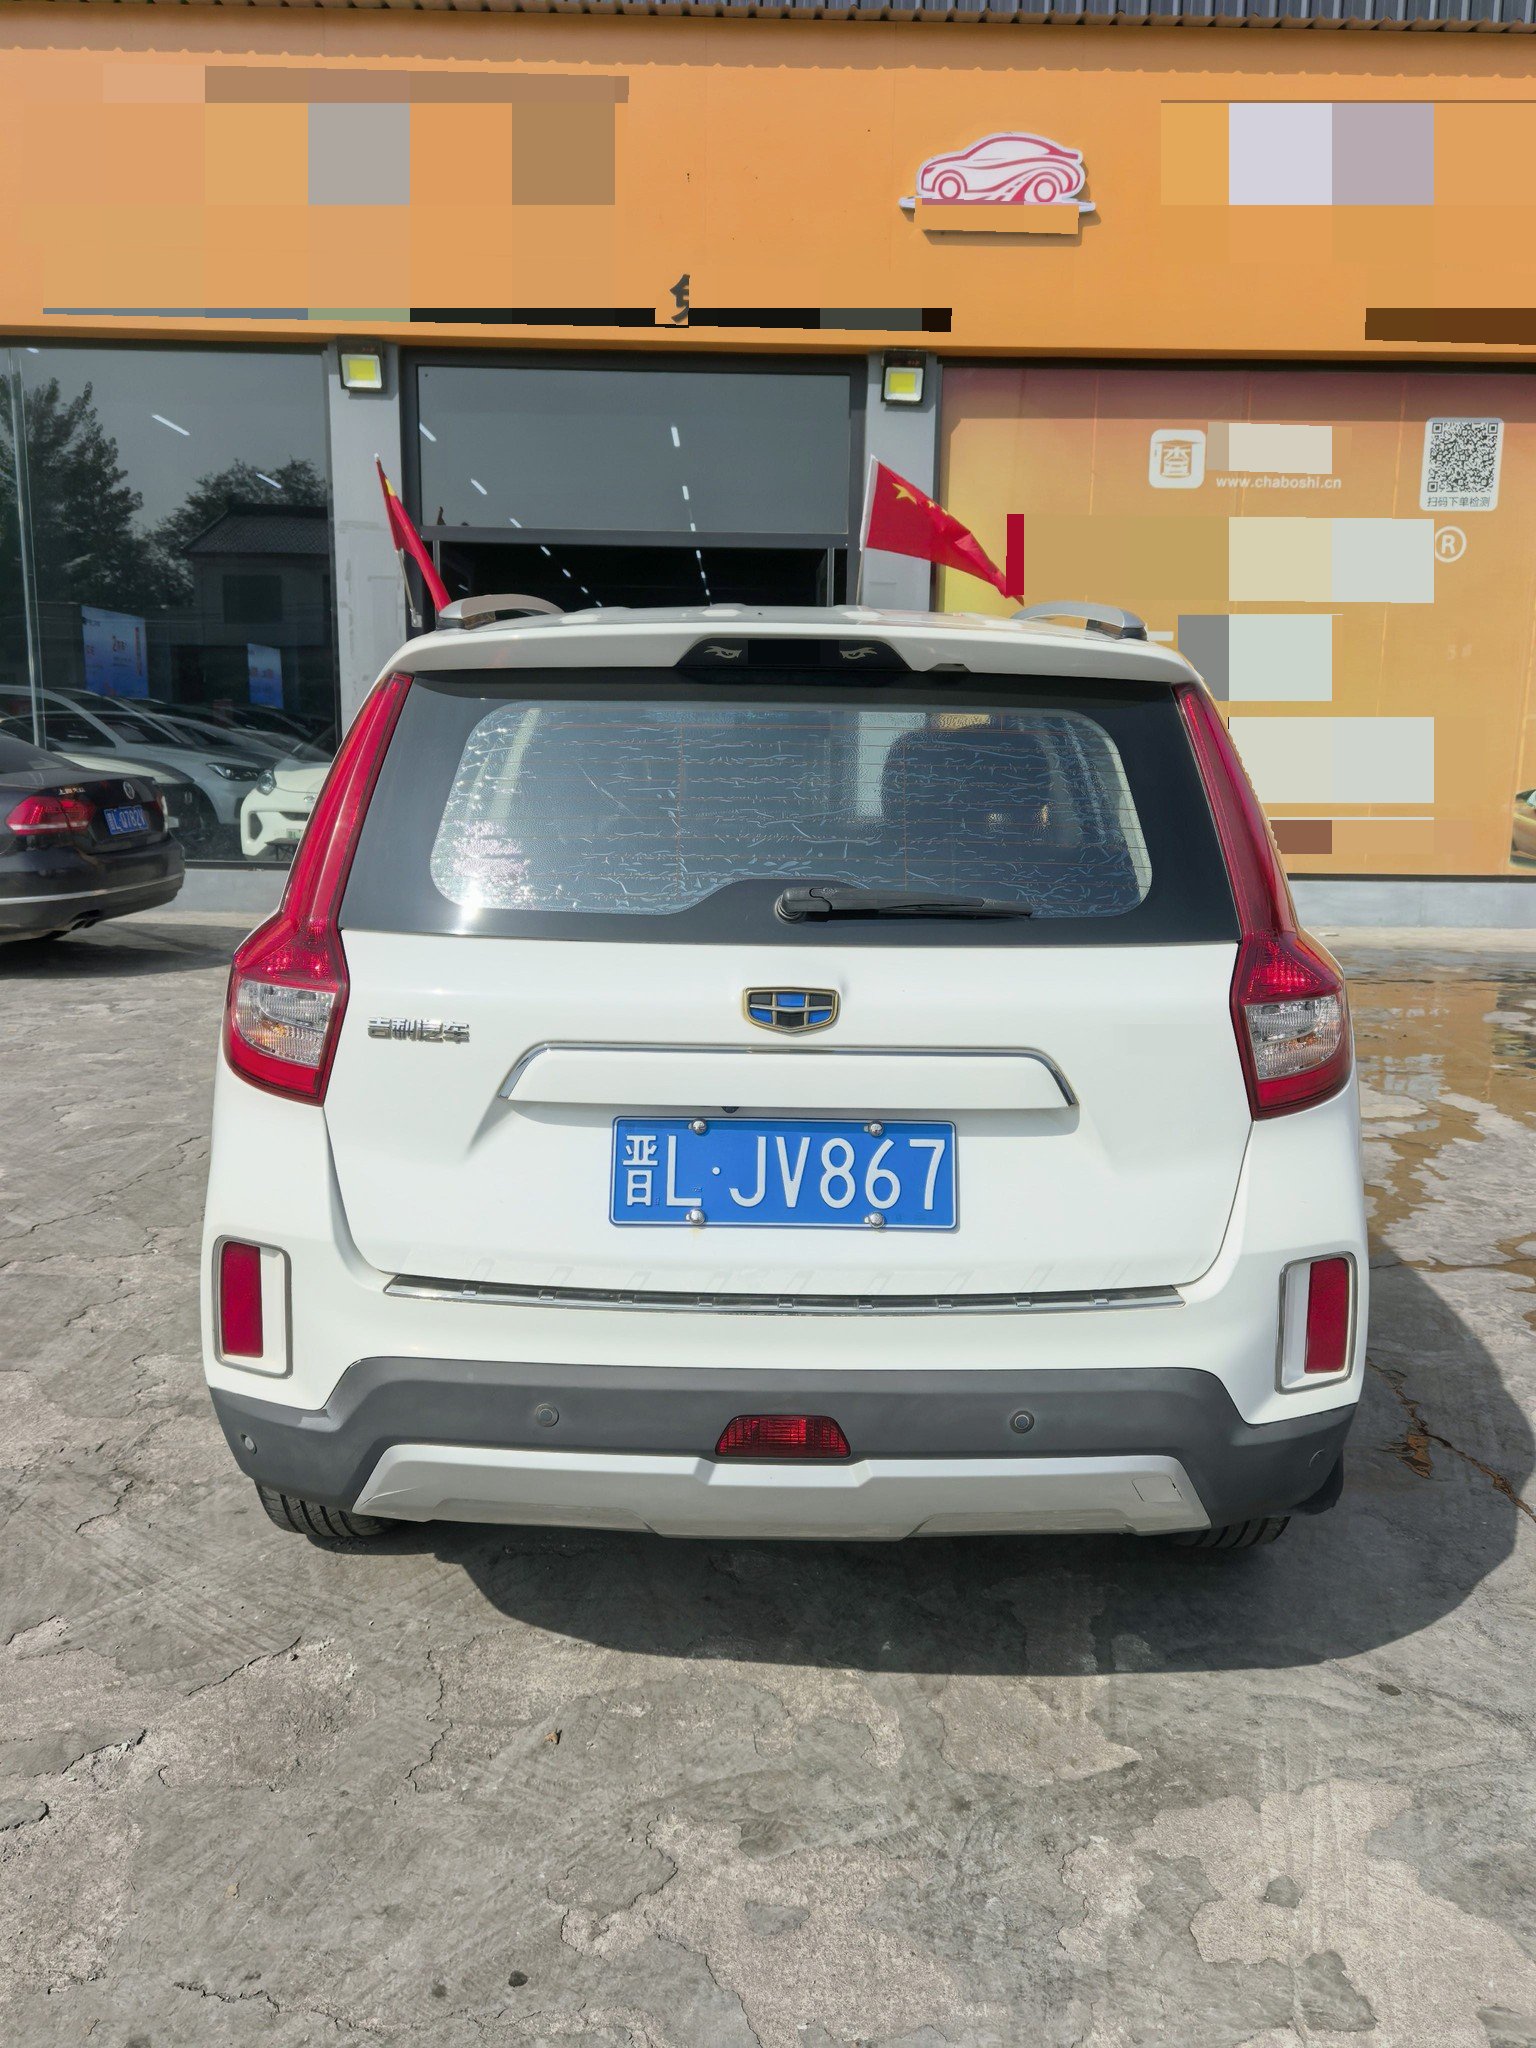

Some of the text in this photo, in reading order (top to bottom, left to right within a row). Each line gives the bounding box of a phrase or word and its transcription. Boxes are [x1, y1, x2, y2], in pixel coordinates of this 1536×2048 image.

[1216, 475, 1342, 489] www.chaboshi.cn
[1426, 496, 1491, 508] 扫码下单检测
[622, 1134, 947, 1211] 晋L·JV867
